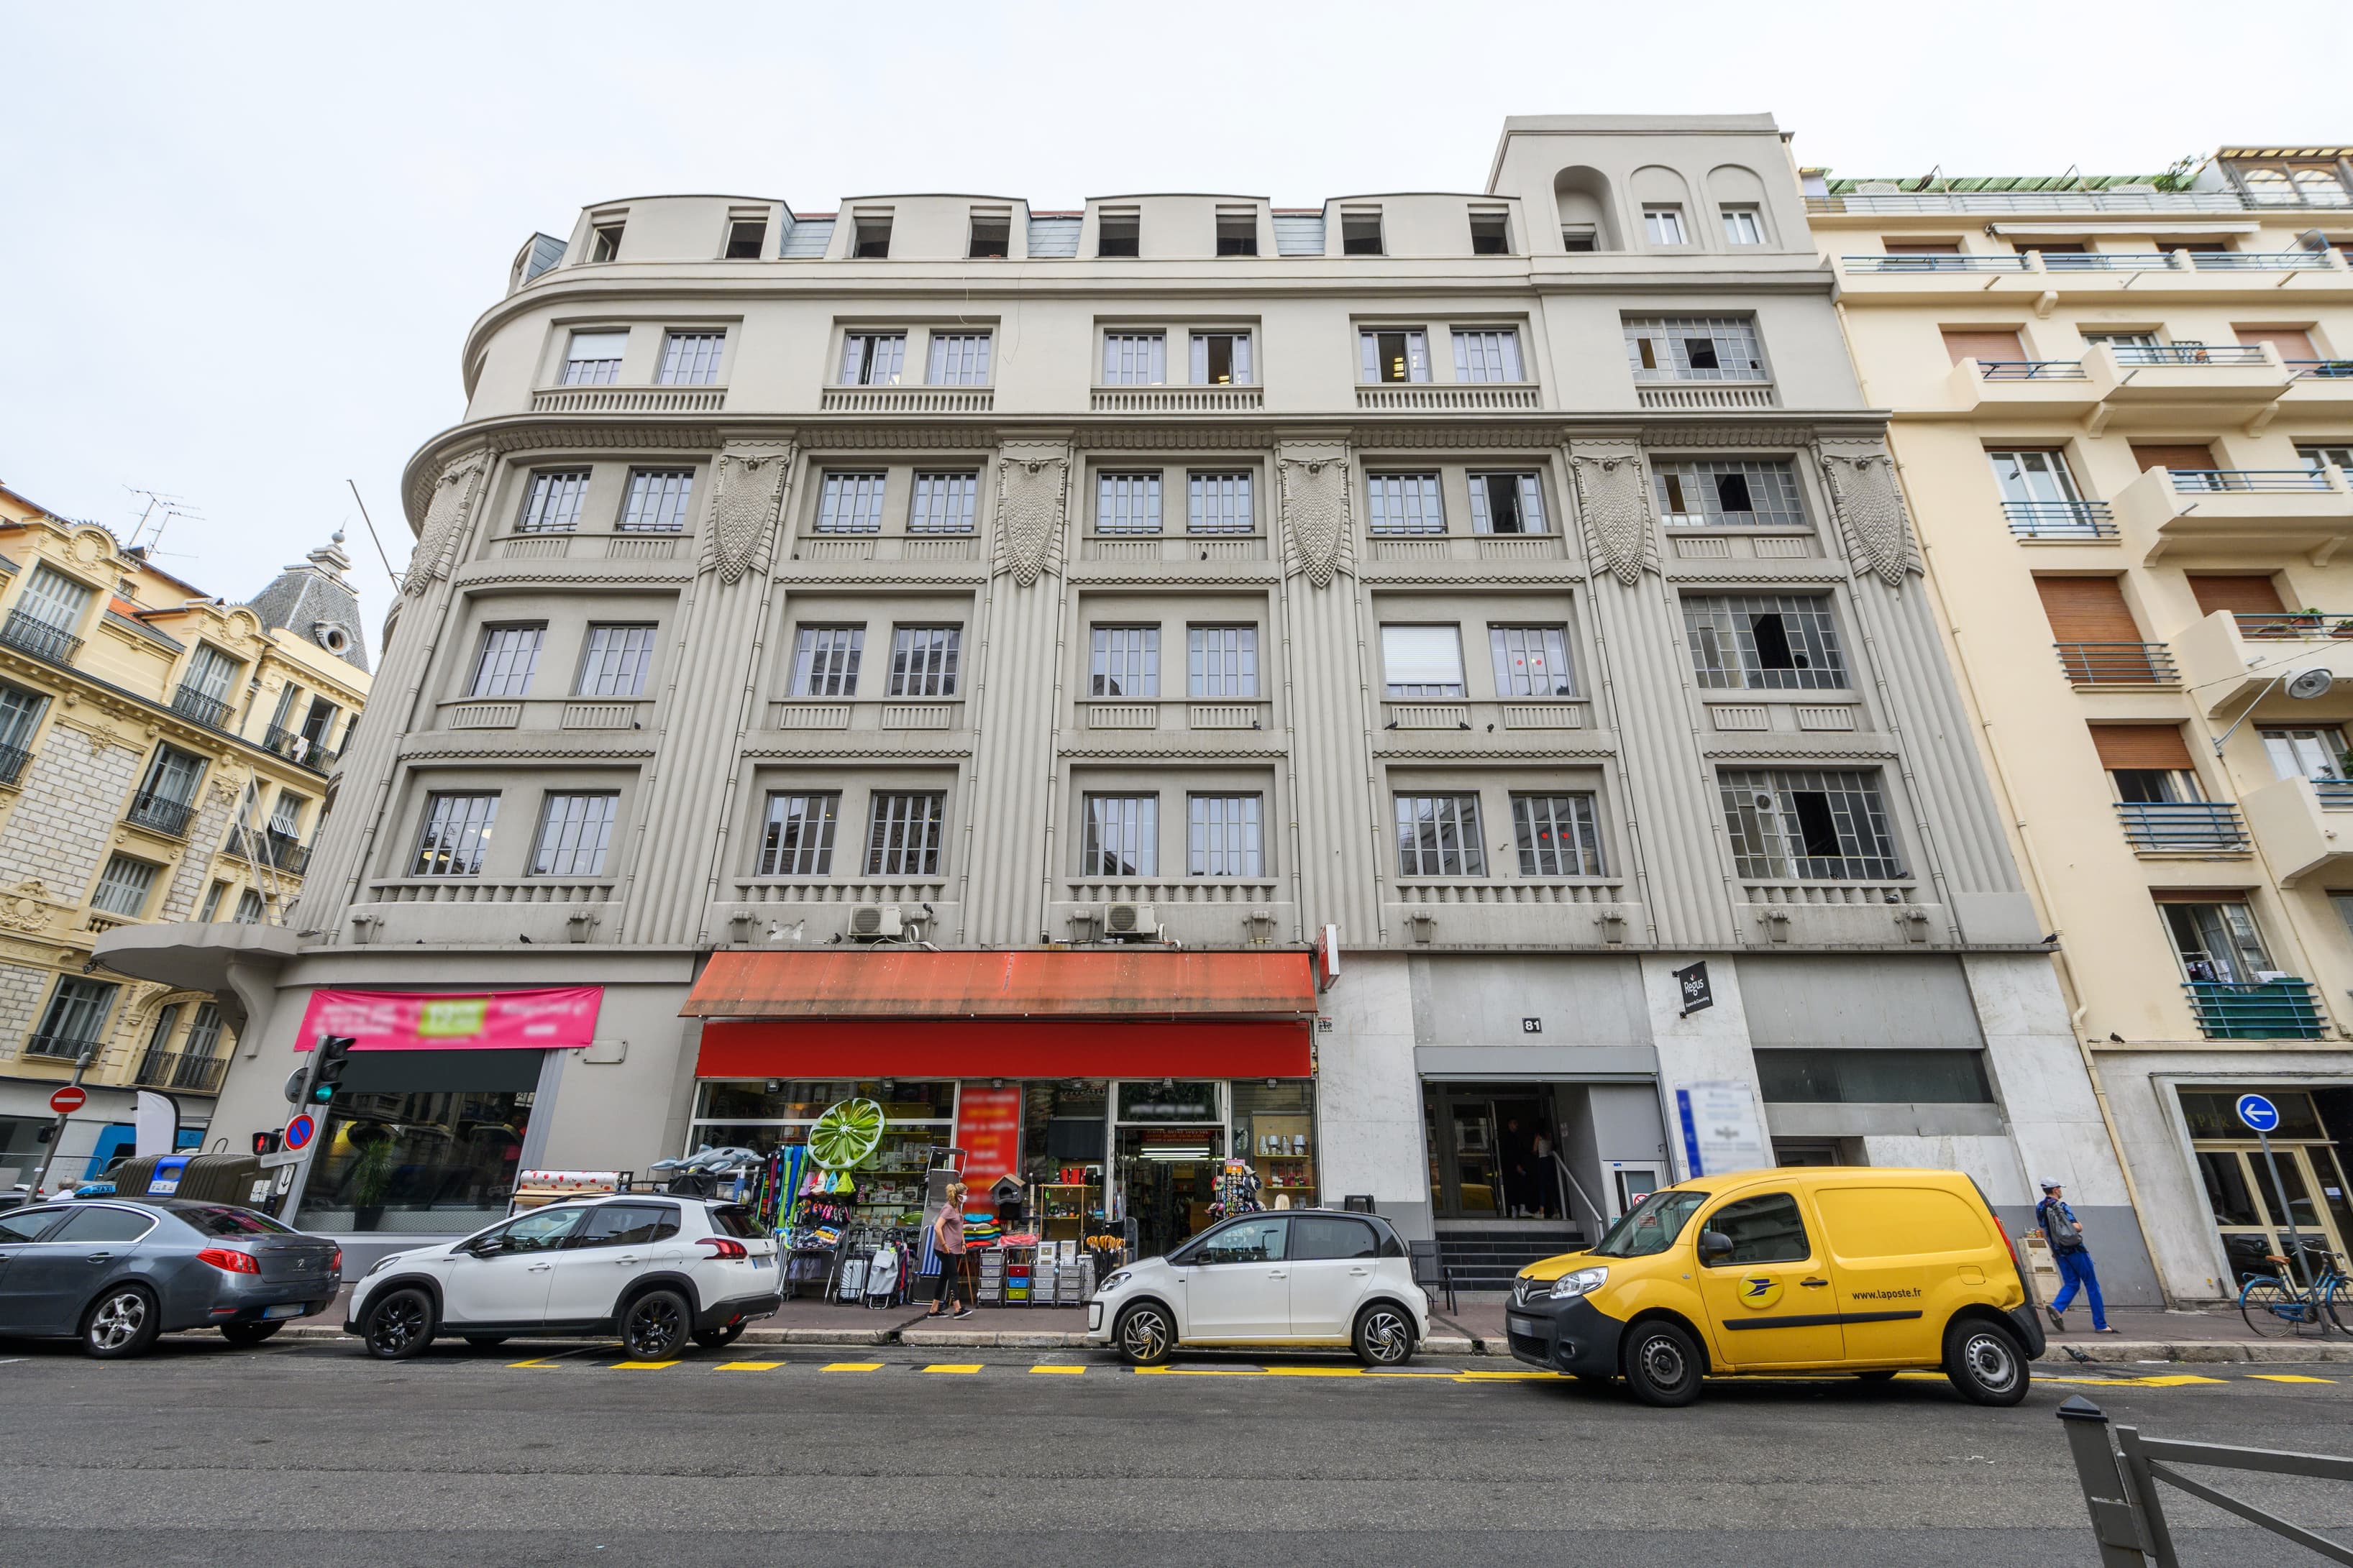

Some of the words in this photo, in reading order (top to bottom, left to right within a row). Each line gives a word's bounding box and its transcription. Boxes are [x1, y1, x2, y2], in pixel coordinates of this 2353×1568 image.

[1683, 978, 1704, 996] Regus
[1525, 1020, 1540, 1030] 81
[1852, 1288, 1922, 1300] www.laposte.fr
